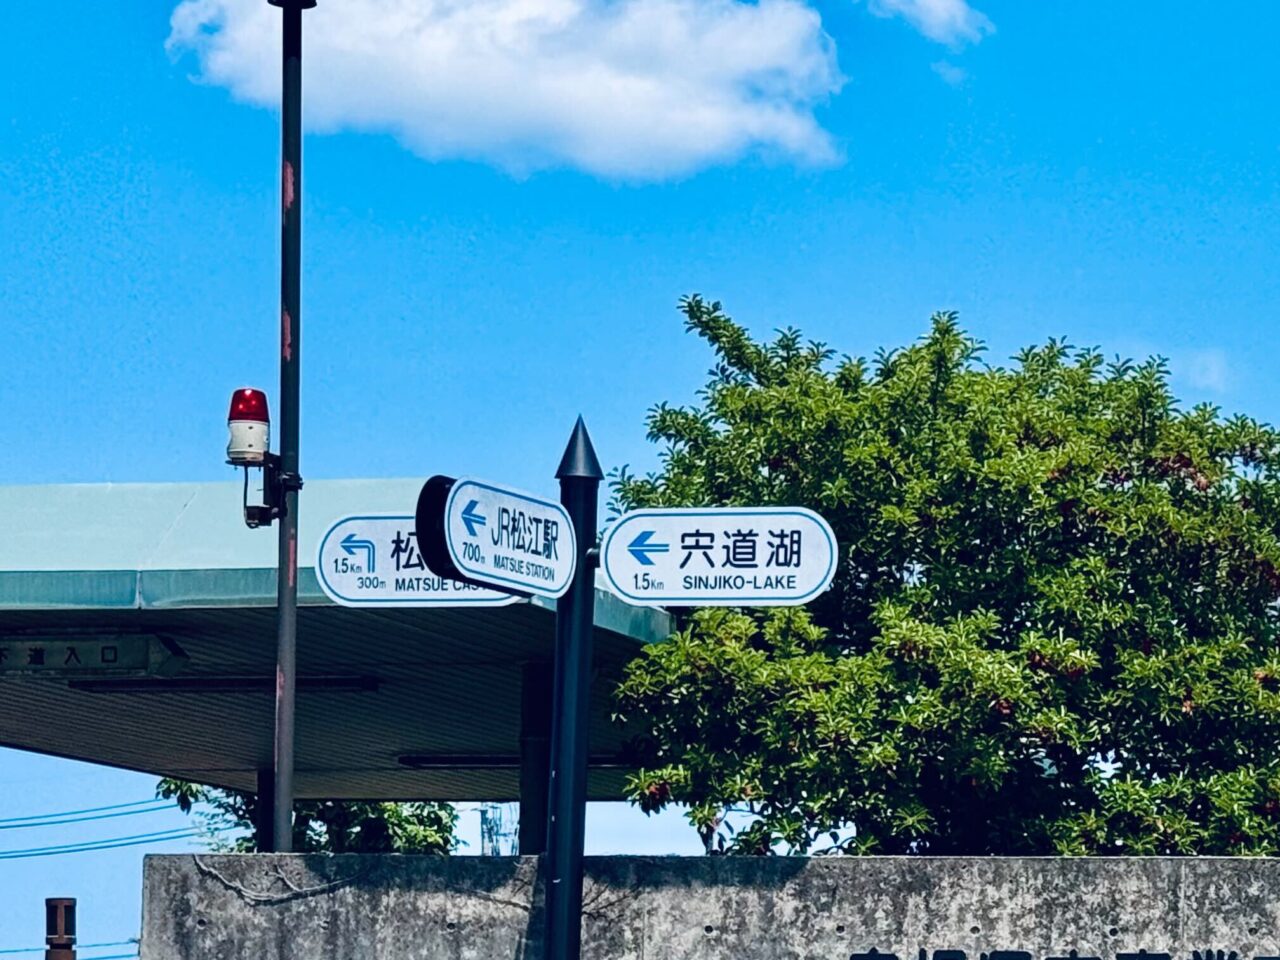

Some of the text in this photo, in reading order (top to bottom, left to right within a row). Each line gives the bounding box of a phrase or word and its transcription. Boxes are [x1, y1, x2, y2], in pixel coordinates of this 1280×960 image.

[491, 506, 559, 561] JR松江駅
[680, 529, 802, 569] 宍道湖
[494, 554, 555, 582] MATSUE STATION
[395, 578, 448, 591] MATSUE
[682, 575, 797, 590] SINJIKO-LAKE
